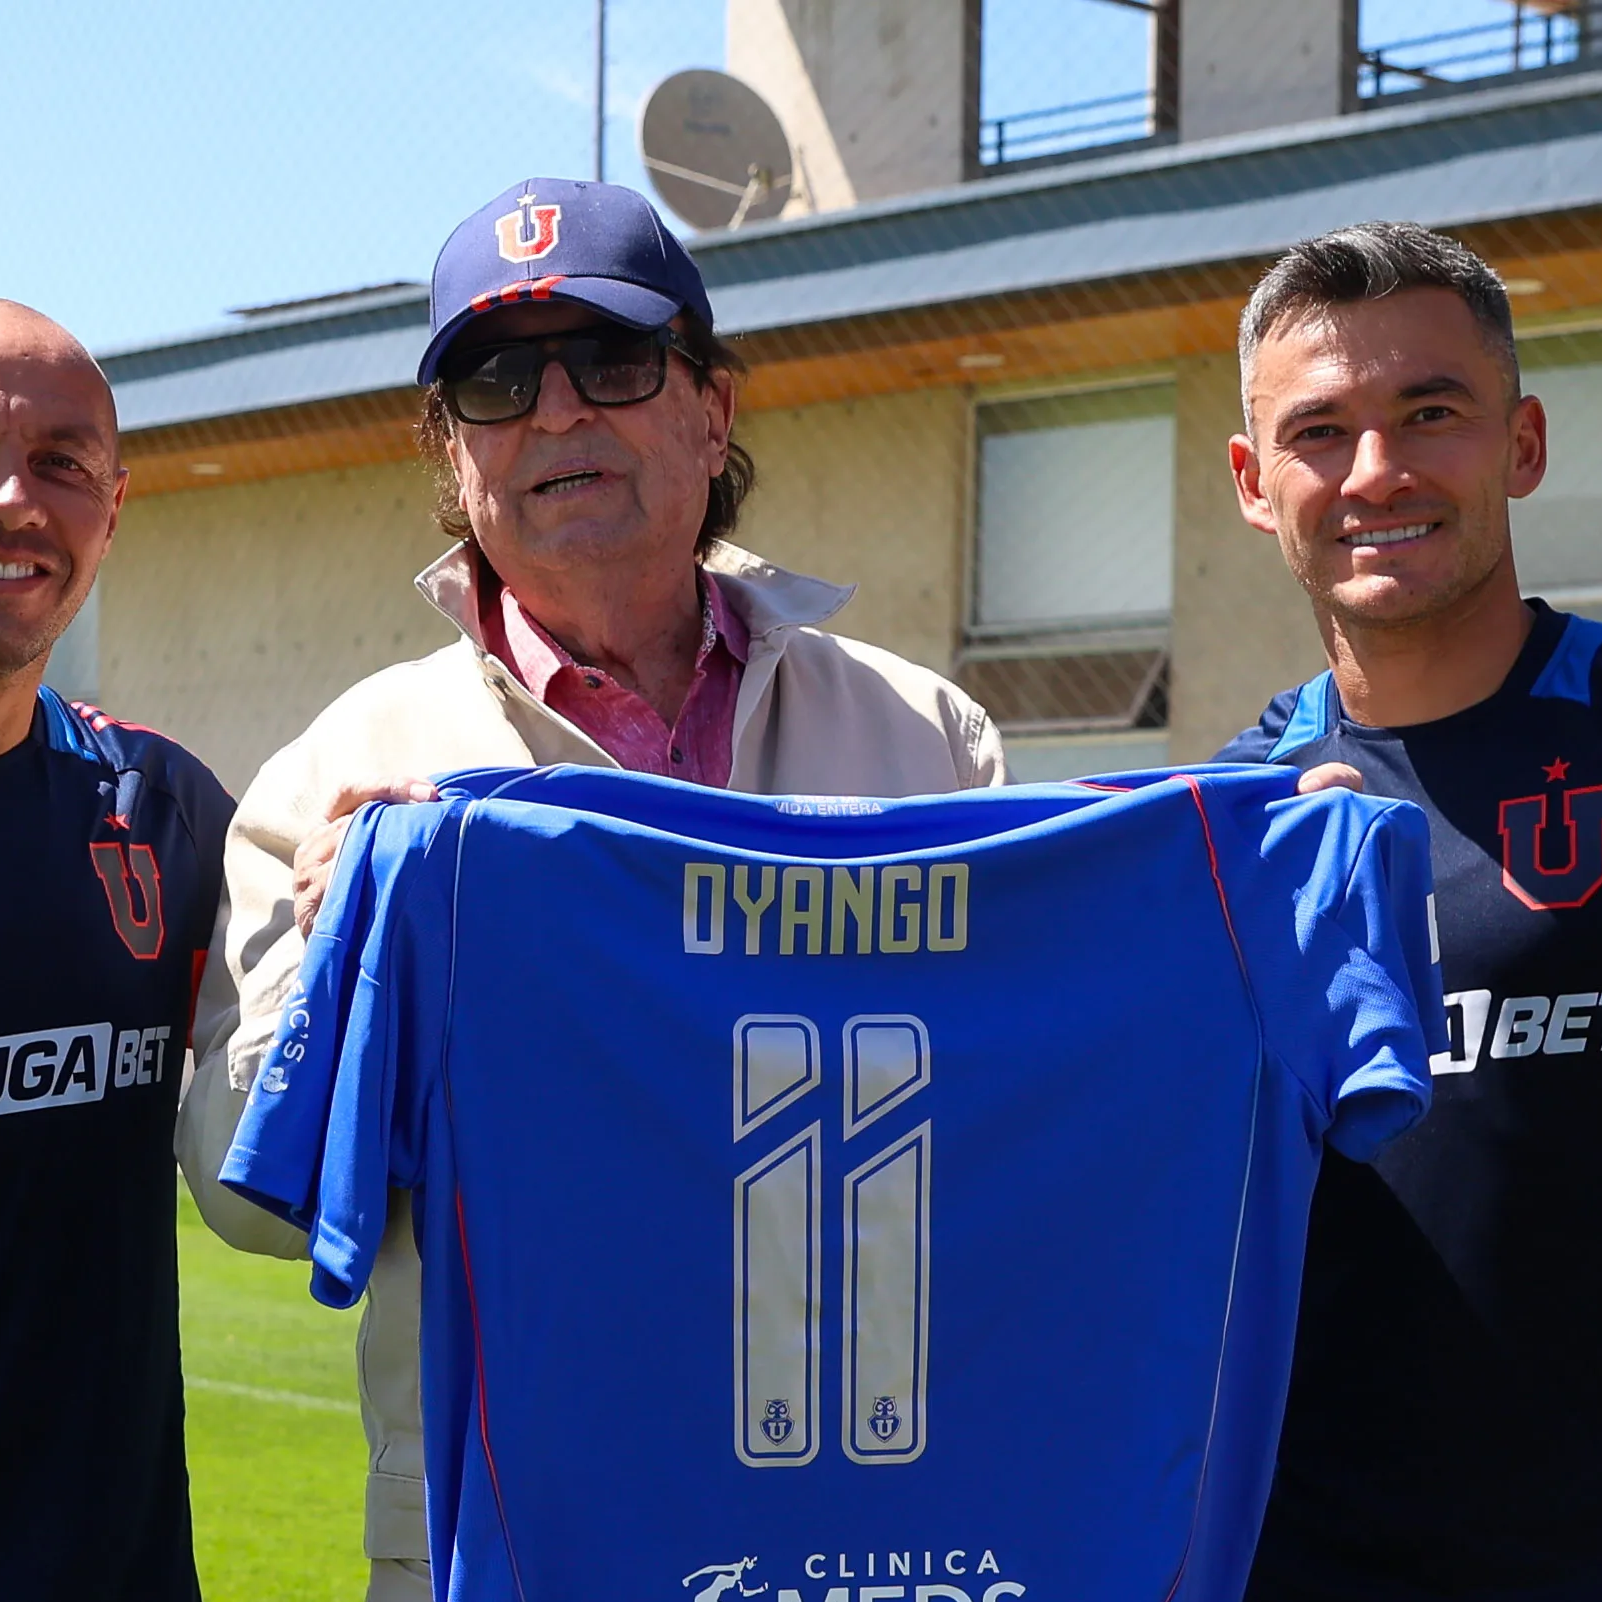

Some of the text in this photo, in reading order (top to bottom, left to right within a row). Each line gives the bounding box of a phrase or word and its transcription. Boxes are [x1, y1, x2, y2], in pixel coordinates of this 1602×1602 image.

[495, 204, 561, 264] U
[774, 801, 883, 817] VIDA ENTERA
[89, 842, 164, 959] U
[683, 862, 969, 955] DYANGO
[733, 1013, 931, 1468] 11
[768, 1422, 787, 1440] U
[875, 1419, 894, 1437] U
[805, 1550, 1000, 1579] CLINICA
